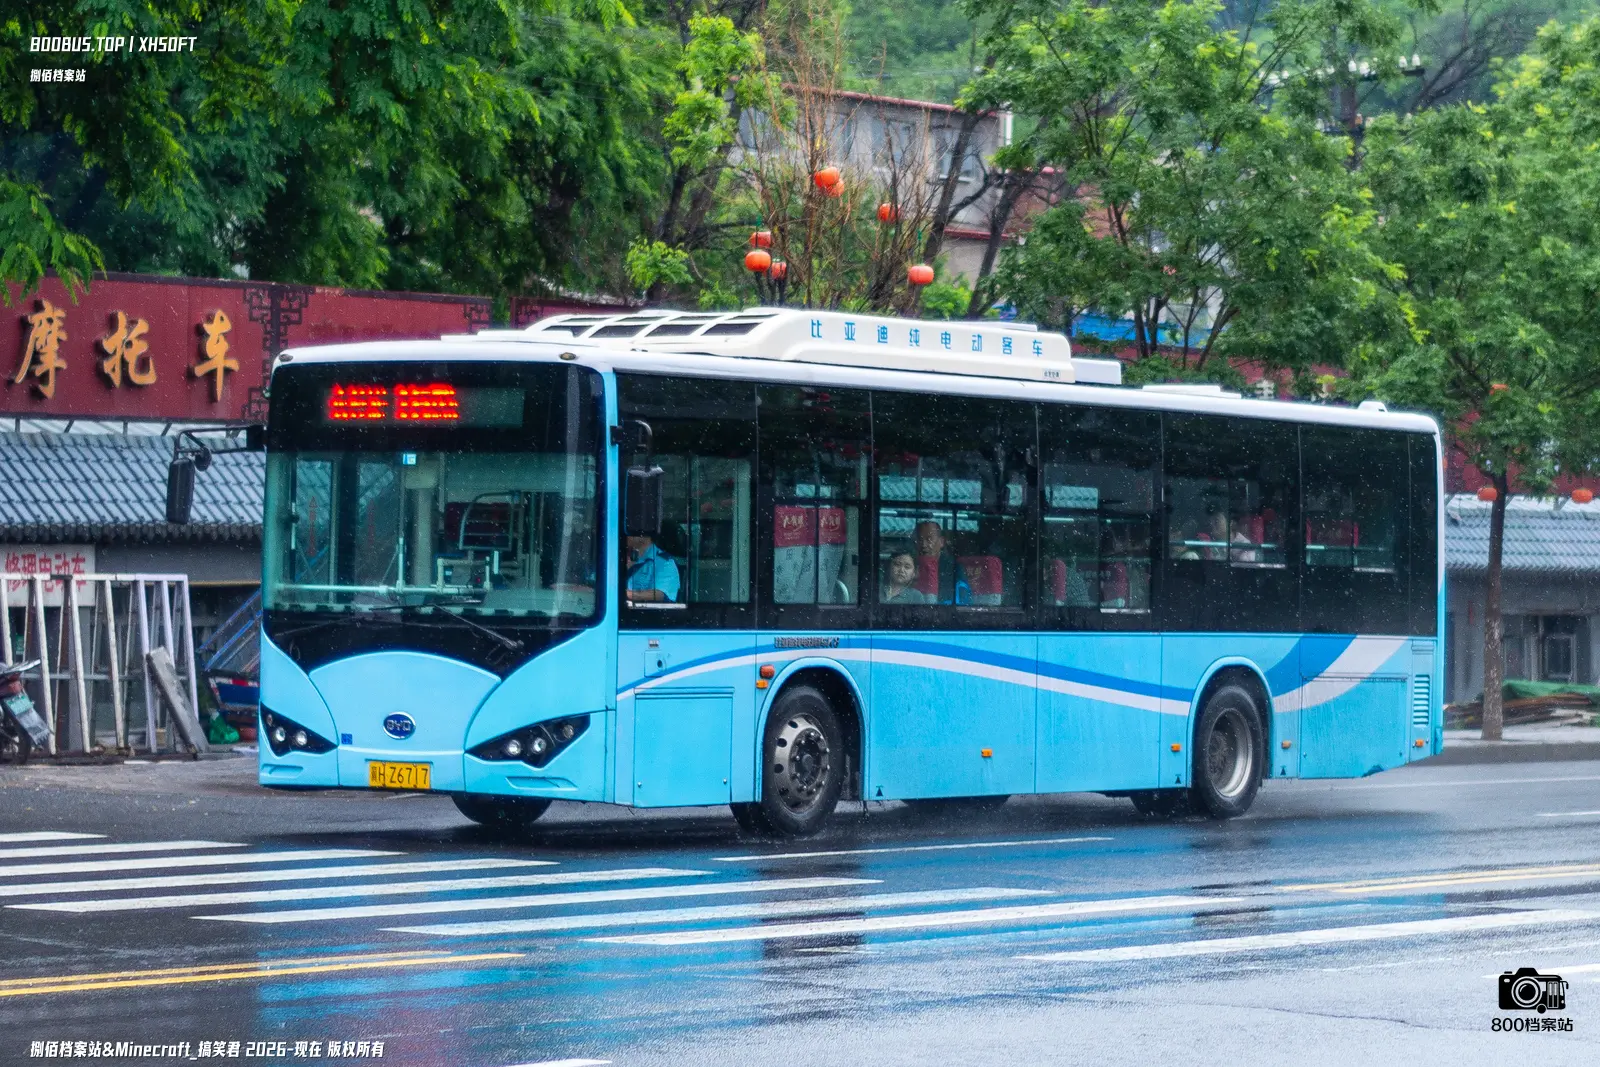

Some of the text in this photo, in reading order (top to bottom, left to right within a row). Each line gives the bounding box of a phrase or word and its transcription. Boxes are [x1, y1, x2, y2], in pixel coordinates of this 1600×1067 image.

[14, 300, 239, 400] 摩托车
[811, 319, 1043, 357] 比亚迪纯电动客车
[386, 719, 411, 731] BYD
